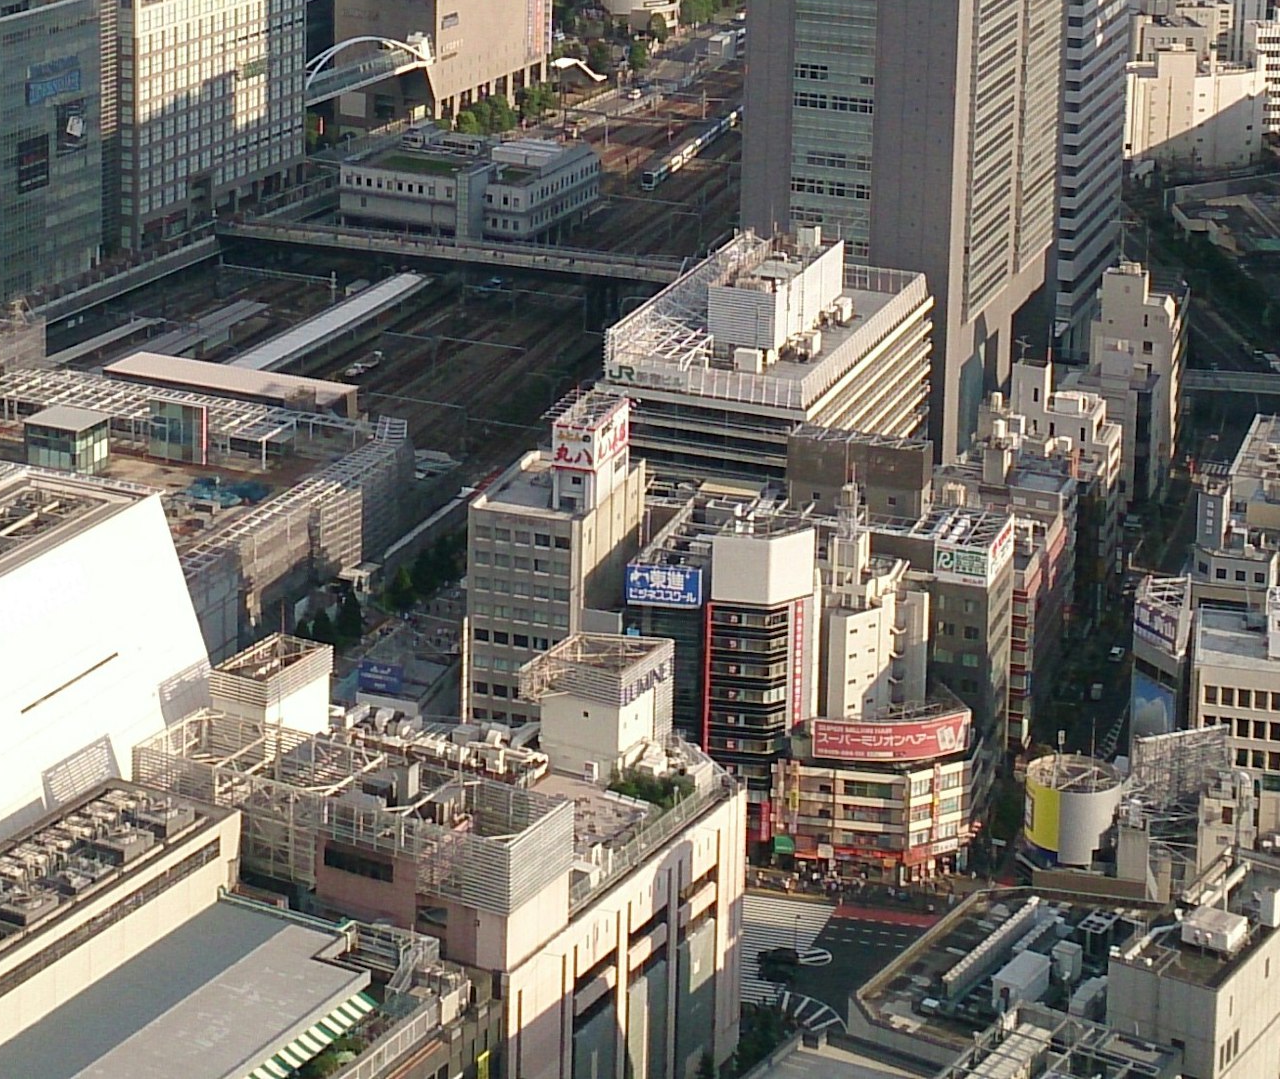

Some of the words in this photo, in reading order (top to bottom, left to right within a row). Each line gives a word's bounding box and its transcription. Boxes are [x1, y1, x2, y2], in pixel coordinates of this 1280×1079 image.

[554, 443, 593, 465] 丸八
[650, 569, 685, 591] 東進
[629, 587, 697, 603] ビジネススクール
[621, 660, 671, 706] LUMINE
[818, 731, 938, 748] スーパーミリオンヘアー
